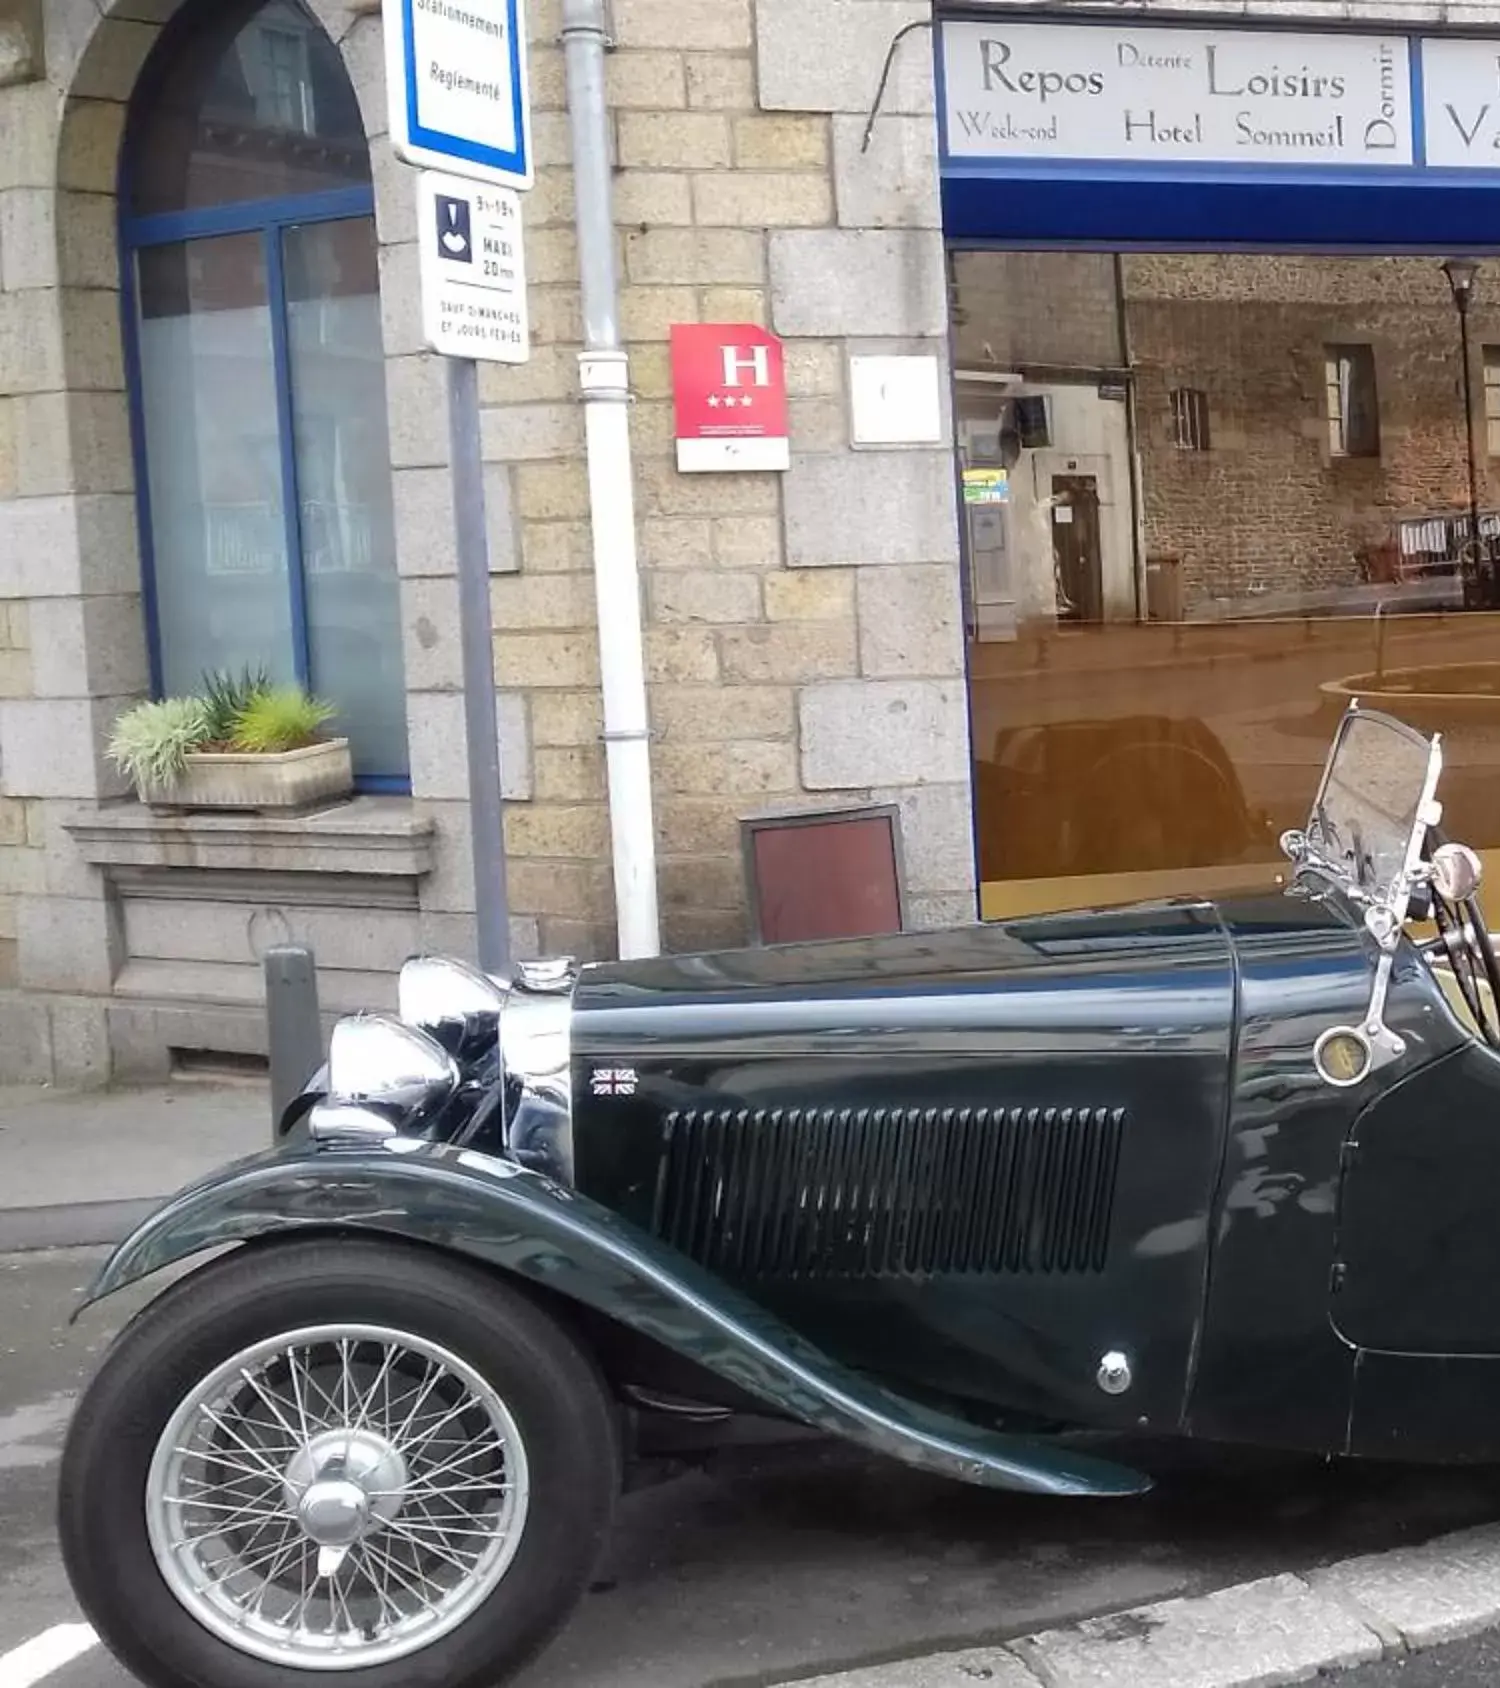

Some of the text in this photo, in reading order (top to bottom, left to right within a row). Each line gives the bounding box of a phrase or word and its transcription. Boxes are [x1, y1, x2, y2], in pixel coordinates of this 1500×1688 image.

[980, 40, 1104, 101] Repos
[1205, 44, 1345, 98] Loisirs
[1363, 44, 1396, 150] Dormir
[956, 110, 1345, 148] Week-end Hotel Sommeil
[719, 345, 771, 387] H
